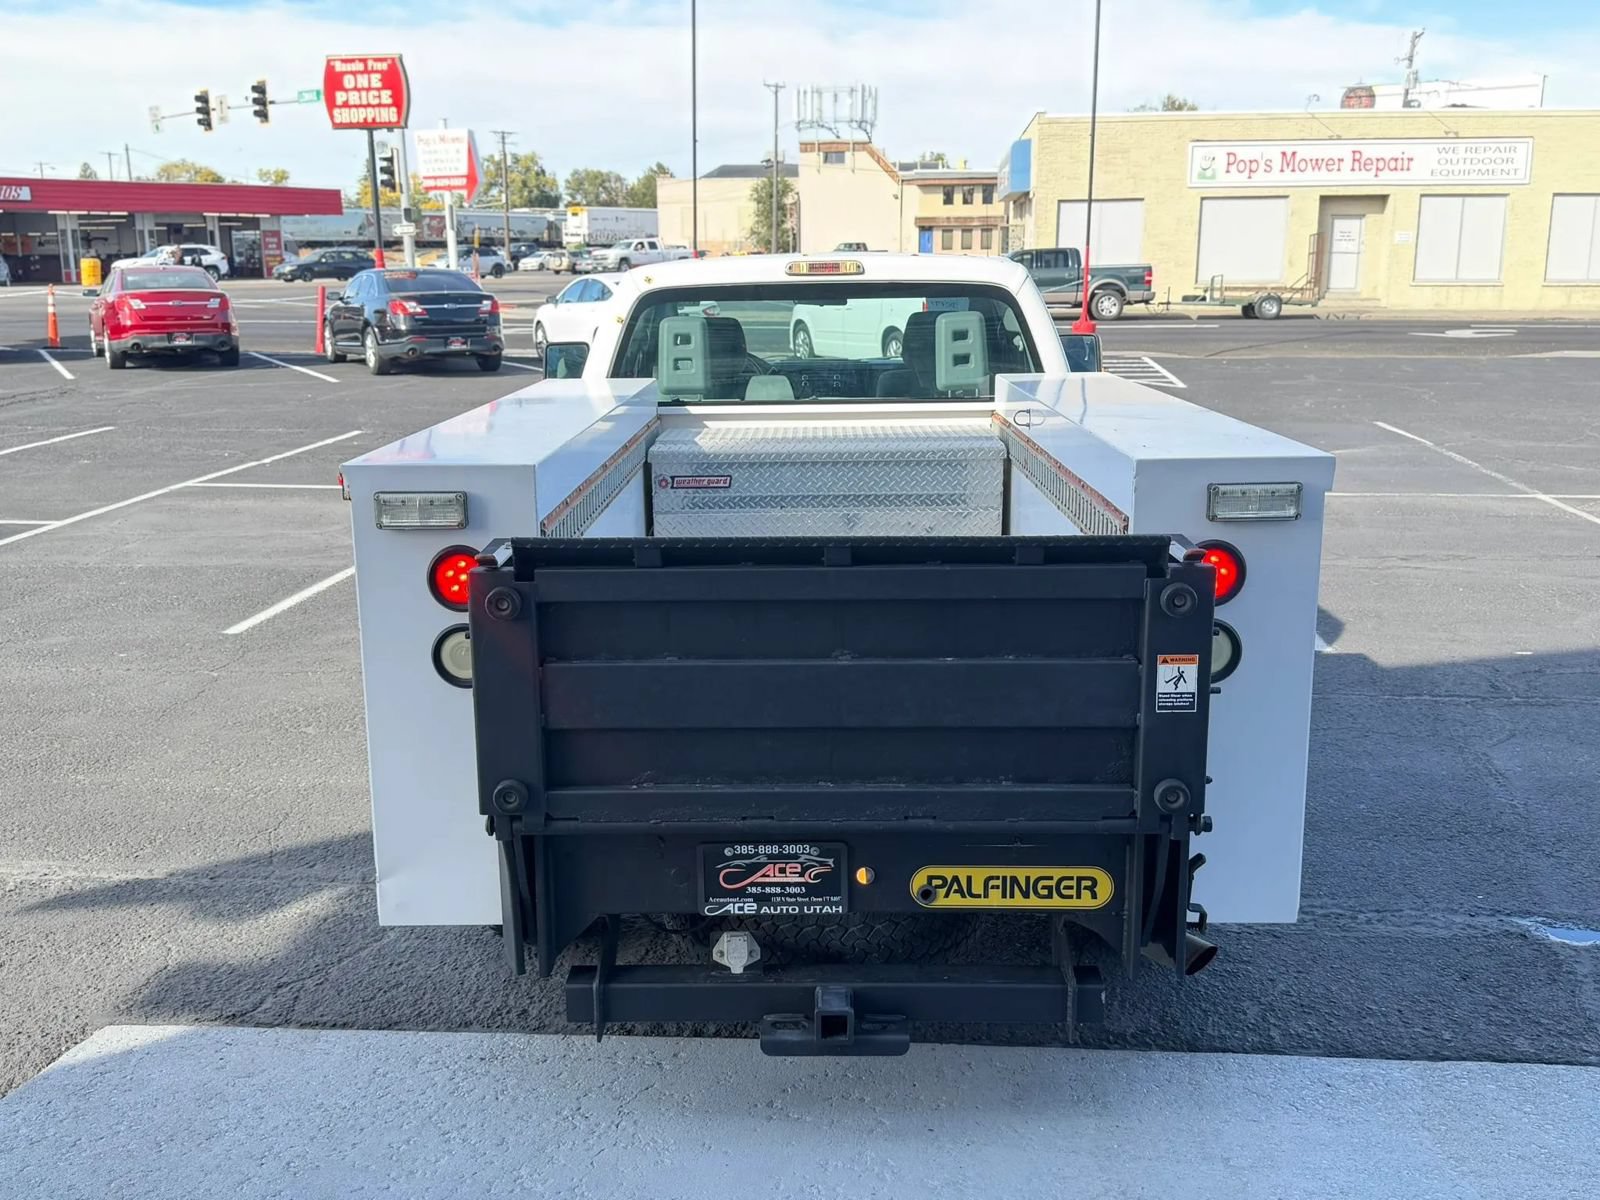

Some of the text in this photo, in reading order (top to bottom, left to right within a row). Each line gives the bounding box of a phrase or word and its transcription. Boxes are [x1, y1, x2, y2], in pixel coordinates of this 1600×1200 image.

[343, 73, 383, 89] ONE
[335, 90, 393, 106] PRICE
[333, 106, 399, 123] SHOPPING
[1437, 145, 1518, 155] WE REPAIR
[1225, 150, 1414, 179] Pop's Mower Repair
[1437, 157, 1515, 166] OUTDOOR
[1430, 168, 1520, 177] EQUIPMENT
[676, 477, 728, 486] weather guard
[734, 845, 810, 854] 385-888-3003
[745, 886, 806, 894] 385-888-3003
[926, 875, 1098, 900] PALFINGER
[760, 905, 799, 914] AUTO
[804, 905, 842, 914] UTAH
